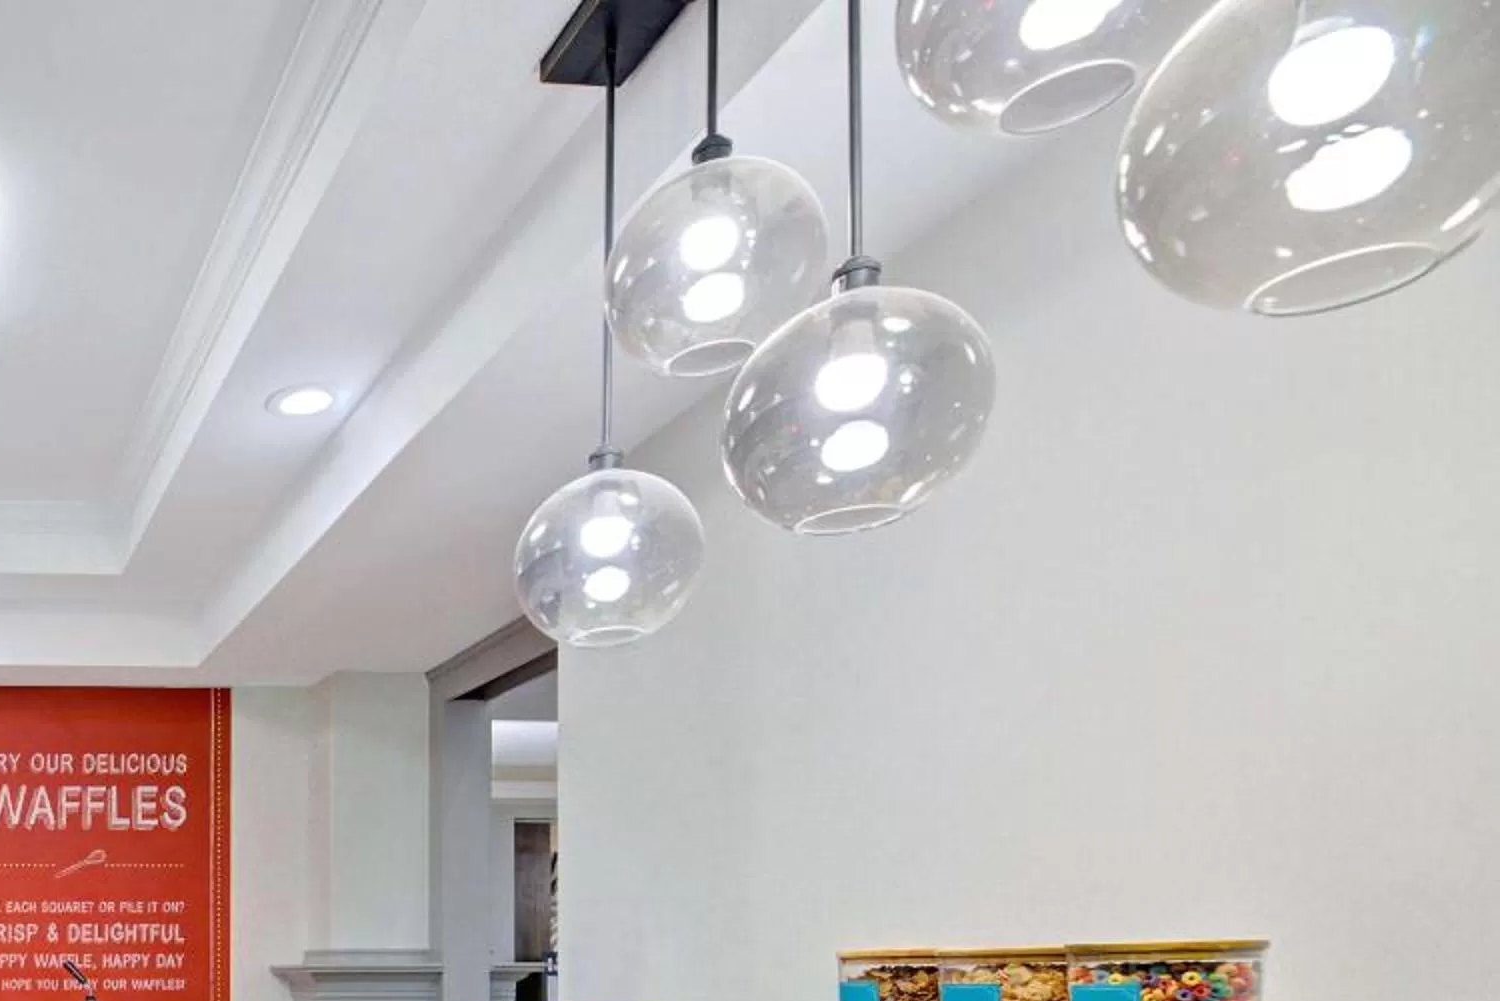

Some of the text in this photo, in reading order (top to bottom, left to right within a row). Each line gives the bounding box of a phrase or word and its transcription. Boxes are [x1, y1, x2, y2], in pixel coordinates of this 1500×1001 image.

[30, 753, 74, 774] OUR
[83, 753, 187, 774] DELICIOUS
[6, 901, 37, 913] EACH
[41, 901, 94, 914] SQUARE?
[100, 901, 115, 913] OR
[120, 901, 143, 913] PILE
[147, 901, 158, 913] IT
[163, 901, 185, 913] ON?
[47, 922, 58, 943] &
[68, 922, 185, 943] DELIGHTFUL
[102, 953, 150, 969] HAPPY
[156, 953, 185, 968] DAY
[2, 979, 32, 991] HOPE
[37, 979, 59, 991] YOU
[103, 979, 127, 991] OUR
